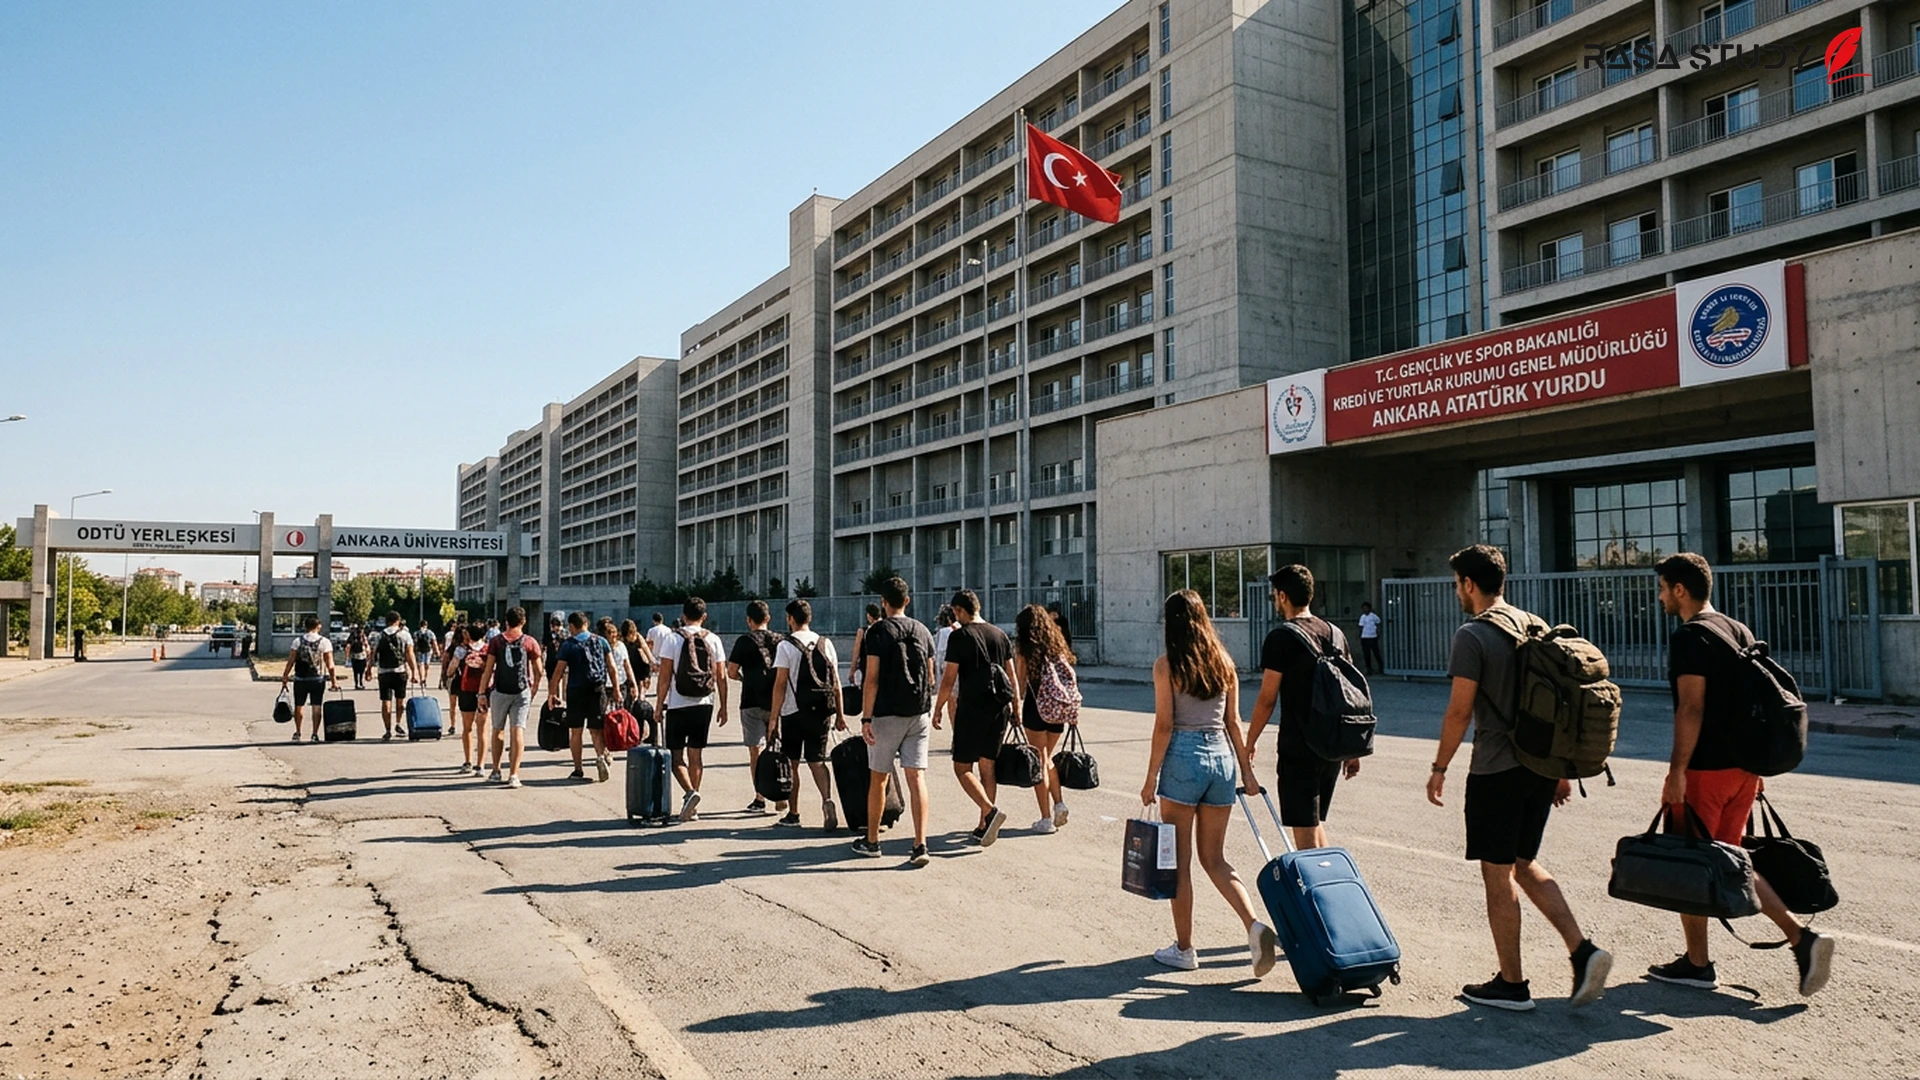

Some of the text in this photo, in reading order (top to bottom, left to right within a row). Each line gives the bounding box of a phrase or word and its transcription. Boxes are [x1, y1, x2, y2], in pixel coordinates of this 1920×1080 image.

[1333, 389, 1367, 411] KREDİ
[1368, 389, 1384, 405] VE
[1385, 378, 1443, 400] YURTLAR
[1445, 365, 1506, 390] KURUMU
[1509, 355, 1557, 377] GENEL
[1560, 328, 1669, 368] MÜDÜRLÜĞÜ
[1375, 320, 1600, 384] T.C. GENÇLİK VE SPOR BAKANLIĞI
[1372, 368, 1607, 428] ANKARA ATATÜRK YURDU
[77, 523, 236, 545] ODTÜ YERLEŞKESİ
[336, 533, 503, 551] ANKARA ÜNİVERSİTESİ
